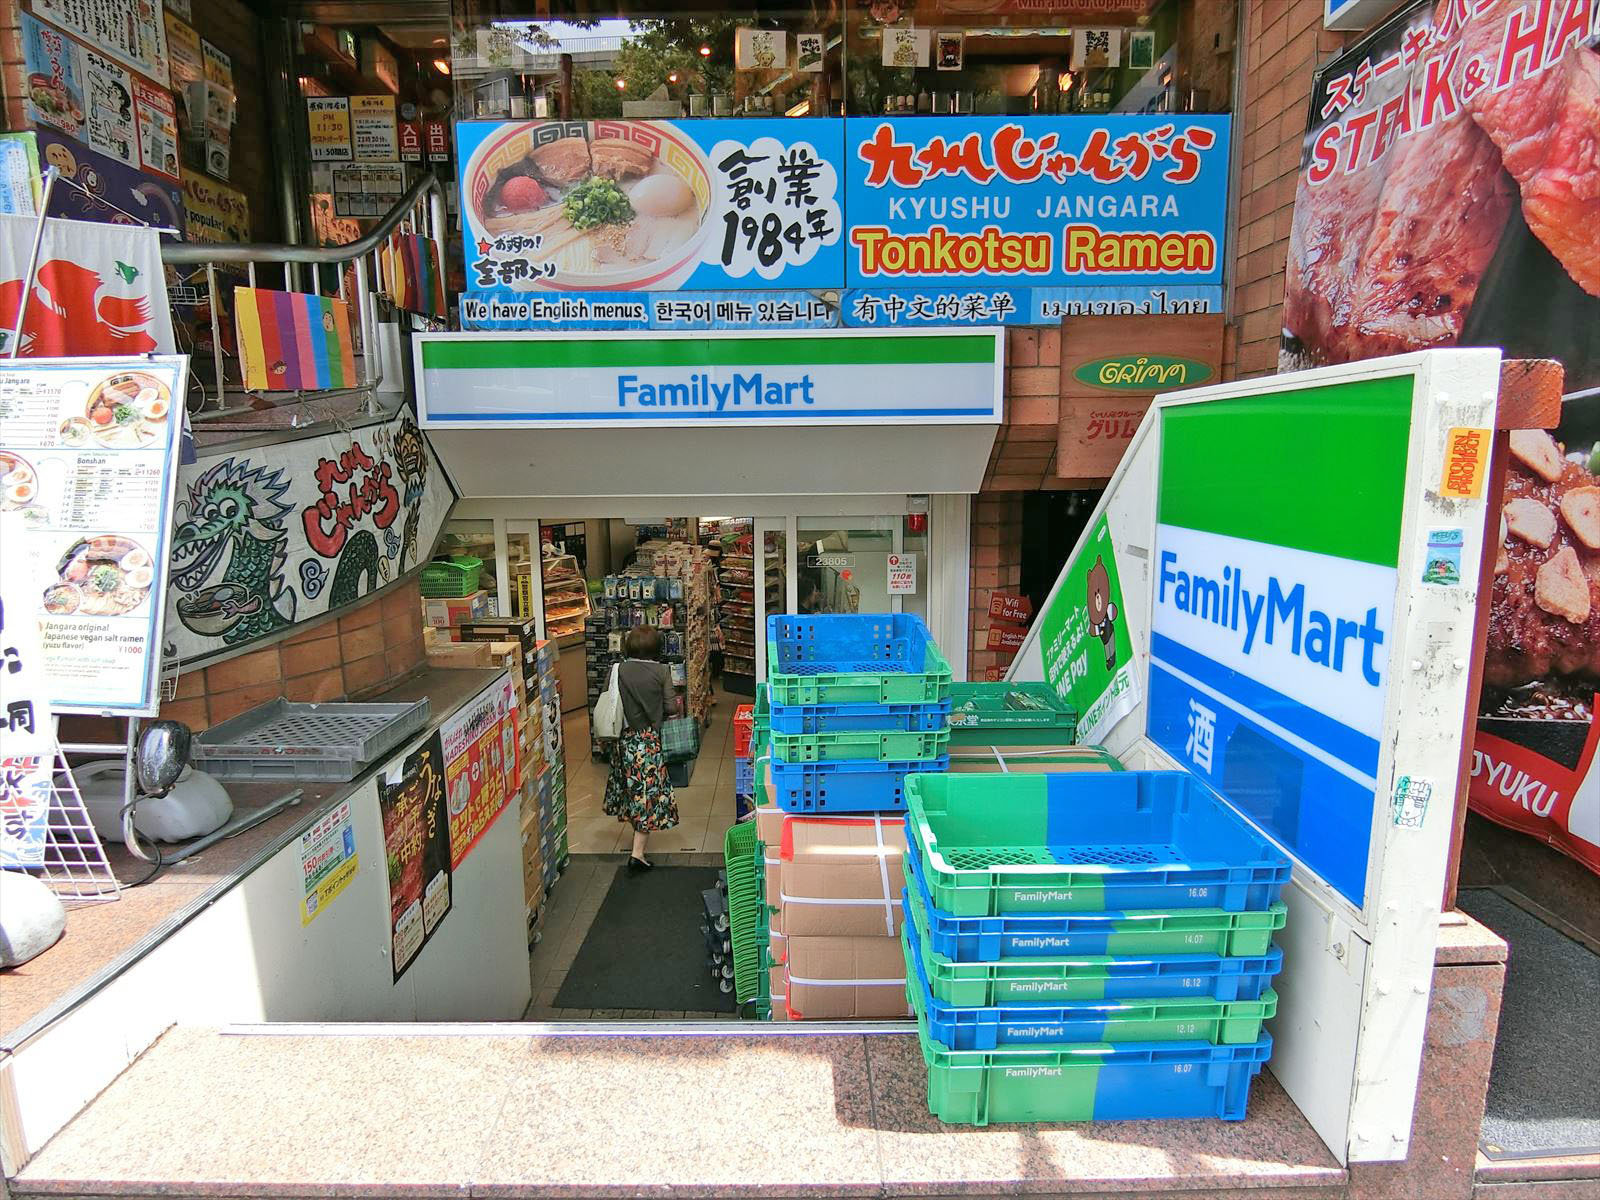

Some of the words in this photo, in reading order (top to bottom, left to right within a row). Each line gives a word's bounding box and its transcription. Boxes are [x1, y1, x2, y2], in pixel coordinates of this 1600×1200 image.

[1306, 39, 1464, 187] STEAK
[1492, 0, 1600, 94] HA
[403, 124, 418, 147] 入口
[430, 124, 444, 147] 出口
[860, 124, 1215, 185] 九州じゃんがら
[717, 149, 824, 211] 創業
[889, 197, 1011, 220] KYUSHU
[1037, 195, 1180, 219] JANGARA
[721, 209, 834, 267] 1984年
[855, 230, 1048, 270] Tonkotsu
[1068, 229, 1210, 270] Ramen
[473, 257, 556, 286] 全部入り
[465, 302, 489, 319] We
[492, 302, 528, 319] have
[533, 302, 590, 322] English
[656, 302, 711, 323] 한국어
[717, 302, 753, 323] 메뉴
[854, 294, 1015, 322] 有中文的菜单
[1042, 291, 1208, 316] เมนของไทย
[617, 373, 815, 413] FamilyMart
[77, 457, 106, 465] Bonshan
[1447, 434, 1468, 491] STOLEN
[1458, 430, 1481, 495] PROJECT
[815, 556, 847, 567] 23805
[1003, 608, 1013, 617] for
[1013, 609, 1028, 619] Free
[1004, 597, 1019, 608] Wifi
[45, 622, 77, 632] Jangara
[78, 622, 110, 632] original
[1158, 550, 1384, 688] FamilyMart
[44, 632, 79, 642] Japanese
[80, 634, 103, 643] vegan
[104, 633, 118, 642] salt
[119, 635, 144, 643] ramen
[1071, 649, 1088, 685] Pay
[1185, 697, 1217, 776] 酒
[1014, 890, 1072, 903] FamilyMart
[1188, 887, 1208, 898] 16.06
[1012, 936, 1070, 948] FamilyMart
[1184, 934, 1203, 944] 14.07
[1010, 981, 1068, 993] FamilyMart
[1182, 977, 1201, 988] 16.12
[1007, 1026, 1063, 1038] FamilyMart
[1176, 1023, 1195, 1033] 12.12
[1005, 1066, 1062, 1078] FamilyMart
[1173, 1063, 1192, 1074] 16.07
